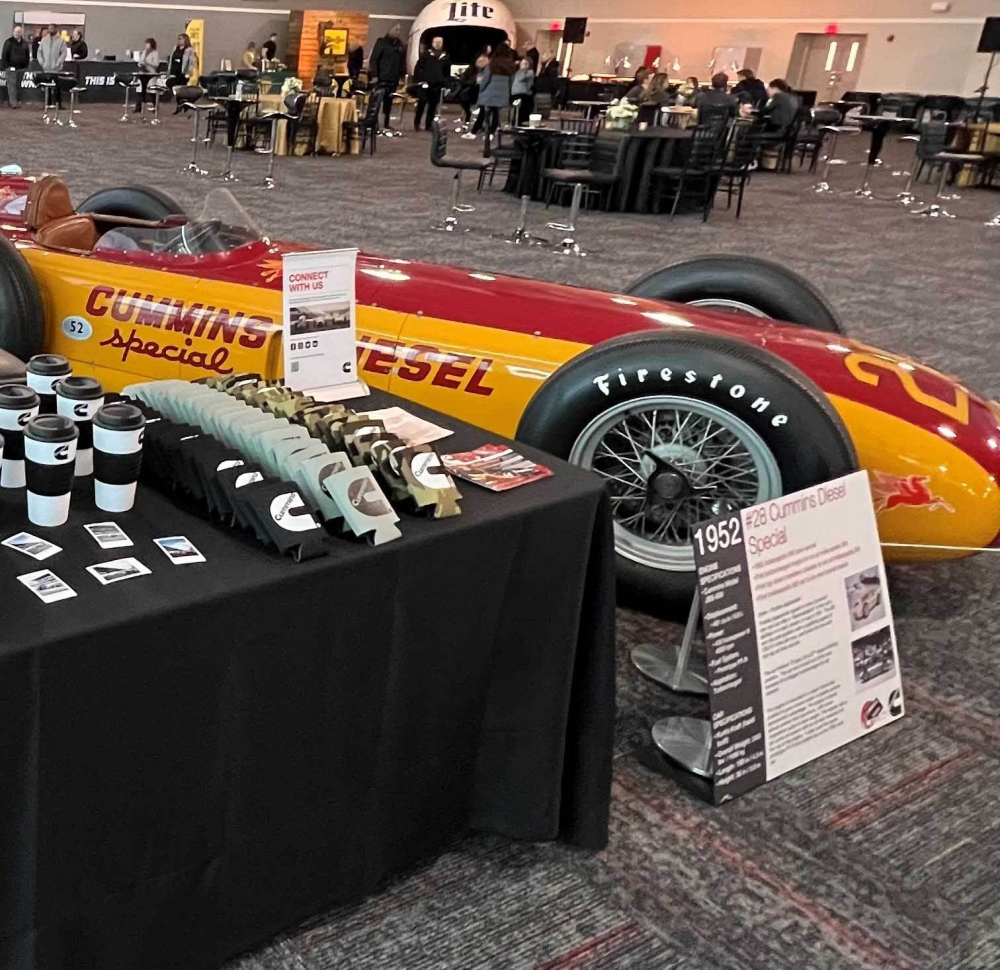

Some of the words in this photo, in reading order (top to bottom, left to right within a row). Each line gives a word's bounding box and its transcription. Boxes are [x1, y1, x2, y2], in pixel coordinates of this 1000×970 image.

[446, 2, 494, 22] Lite
[85, 76, 105, 86] THIS
[289, 271, 329, 283] CONNECT
[289, 283, 310, 292] WITH
[312, 281, 324, 290] US
[69, 319, 84, 334] 52
[86, 285, 274, 349] CUMMINS
[356, 335, 494, 396] IESEL
[100, 328, 233, 375] special
[593, 367, 788, 427] Firestone
[274, 492, 296, 521] Cummins
[746, 507, 766, 528] #28
[769, 496, 817, 522] Cummins
[818, 482, 846, 507] Diesel
[694, 518, 742, 556] 1952
[749, 528, 788, 556] Special
